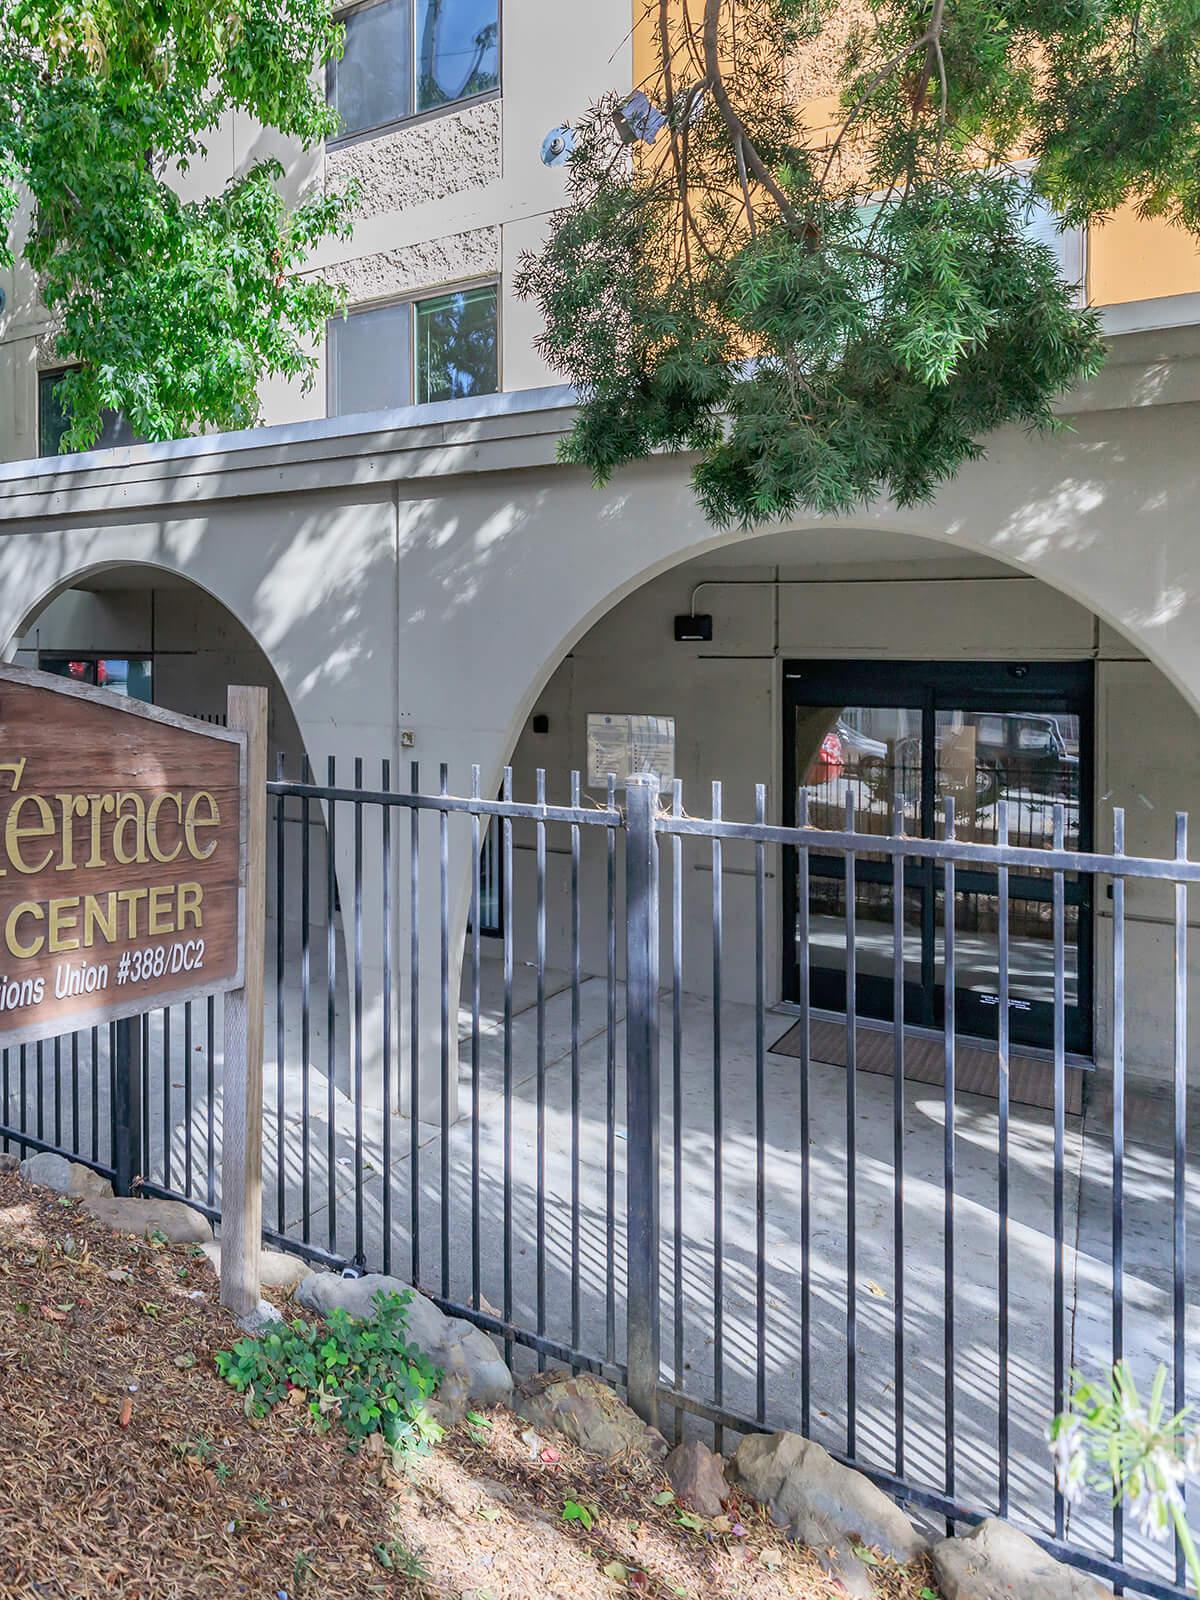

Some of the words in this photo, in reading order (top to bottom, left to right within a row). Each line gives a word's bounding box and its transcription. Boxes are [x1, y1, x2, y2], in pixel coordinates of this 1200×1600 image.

[5, 882, 205, 960] CENTER
[54, 962, 109, 1001] Union
[115, 938, 206, 986] #388/DC2
